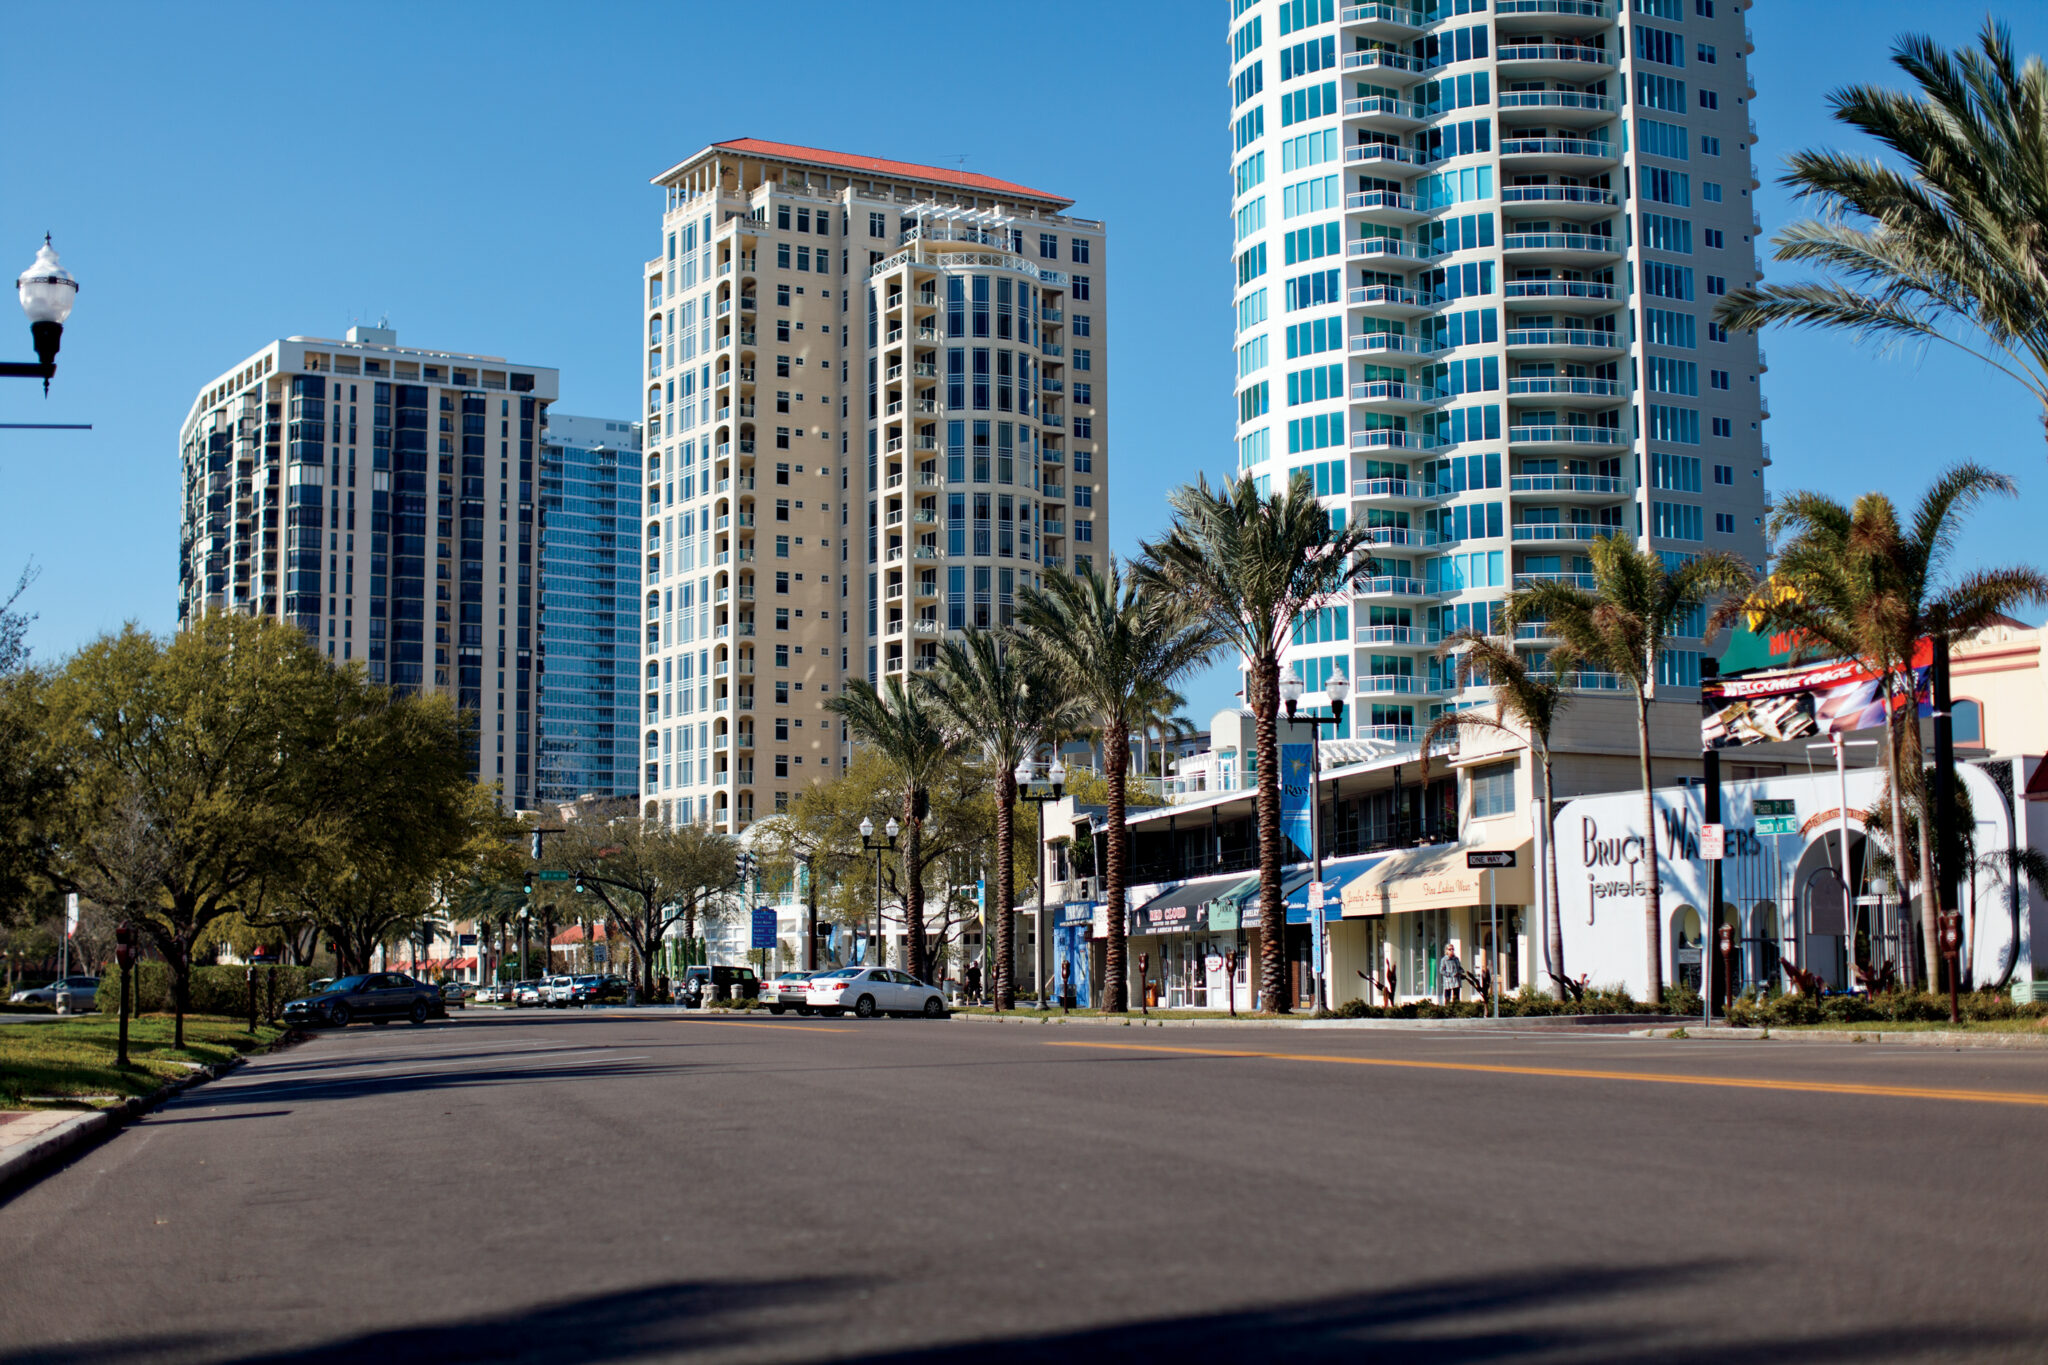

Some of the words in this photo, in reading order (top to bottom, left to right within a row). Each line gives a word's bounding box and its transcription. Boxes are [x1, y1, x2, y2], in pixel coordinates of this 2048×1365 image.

[1723, 675, 1806, 697] WELCOME
[1804, 664, 1856, 686] RACE
[1753, 801, 1771, 814] Plaza
[1662, 807, 1761, 860] WAERS
[1755, 819, 1774, 833] Beach
[1786, 819, 1796, 832] NE
[1471, 856, 1485, 864] ONE
[1487, 855, 1500, 864] WAY
[1586, 873, 1664, 926] jeweles
[1149, 909, 1163, 921] RED
[1164, 906, 1187, 921] CLOUD
